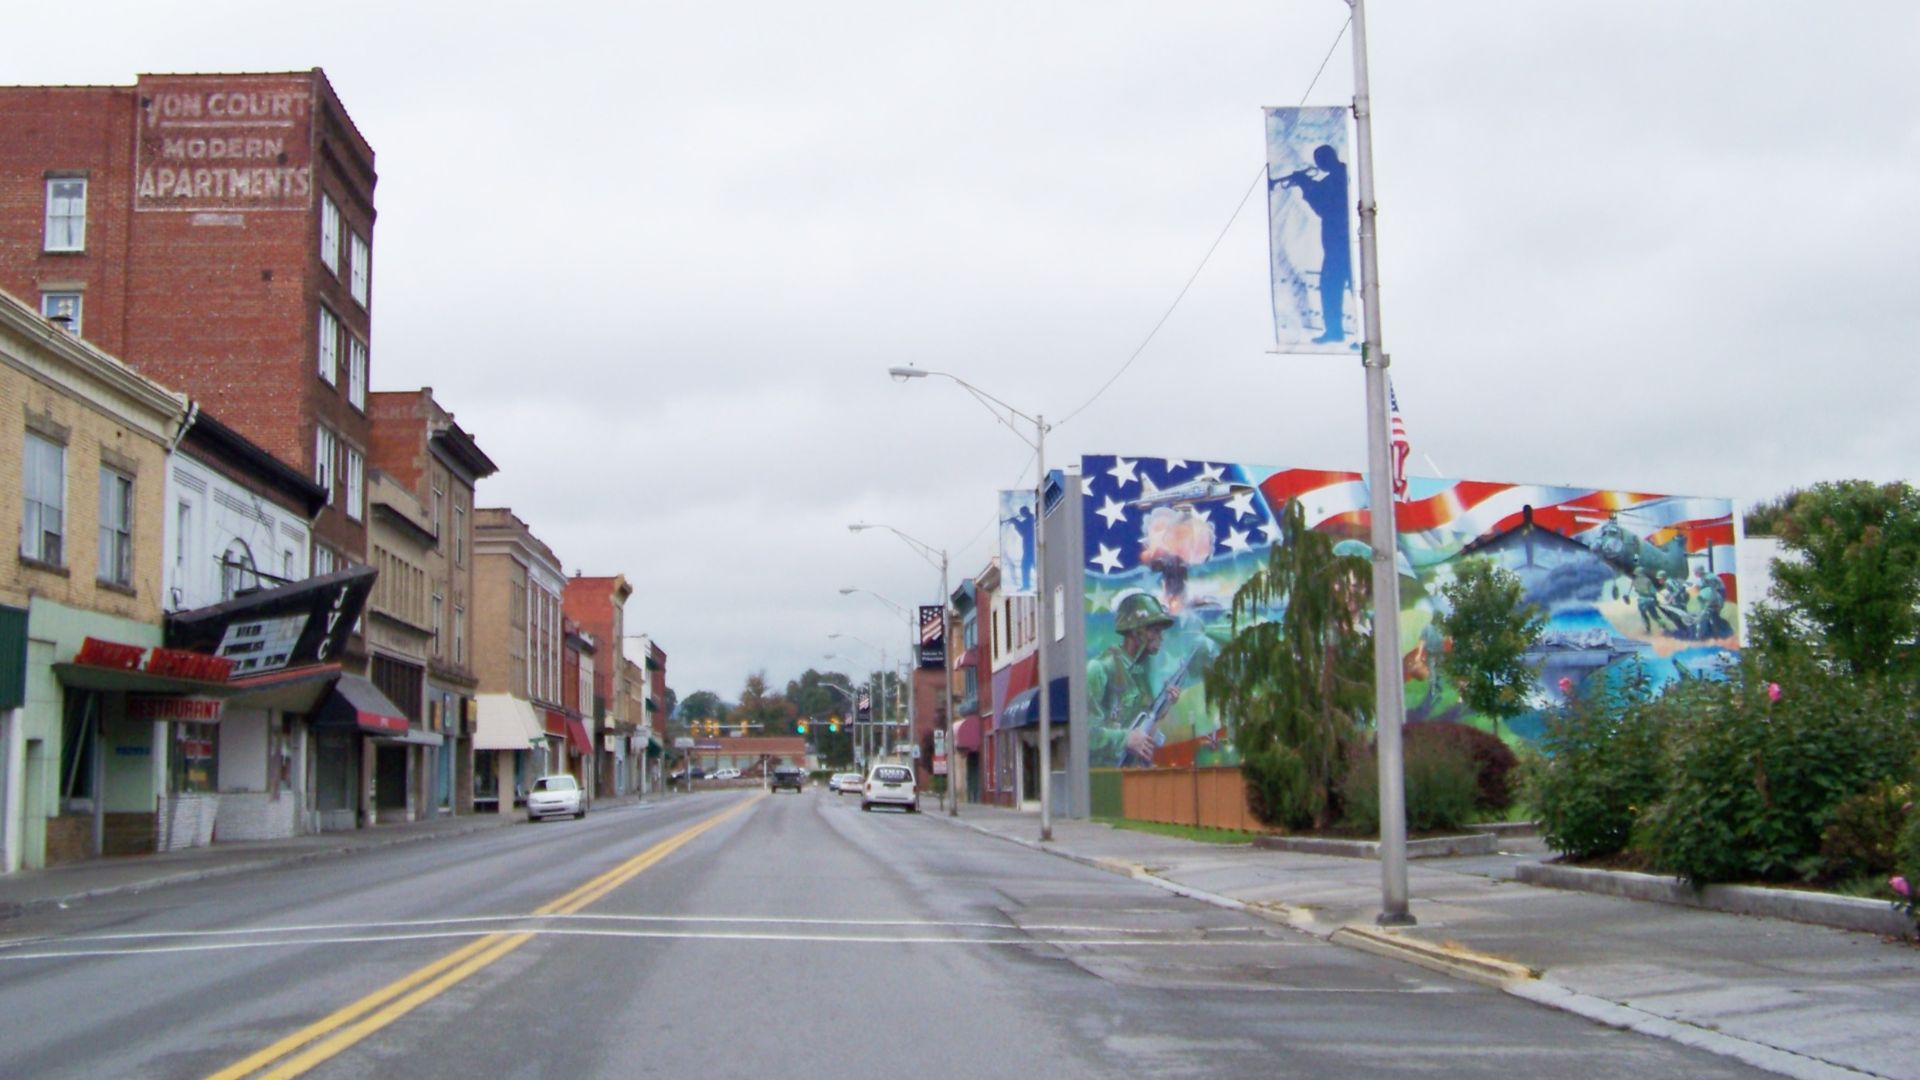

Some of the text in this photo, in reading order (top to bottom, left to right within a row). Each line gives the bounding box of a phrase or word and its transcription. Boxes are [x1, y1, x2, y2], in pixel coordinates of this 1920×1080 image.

[207, 92, 310, 117] COURT
[163, 138, 284, 159] MODERN
[139, 168, 310, 198] APARTMENTS
[128, 699, 221, 719] RESTAURANT
